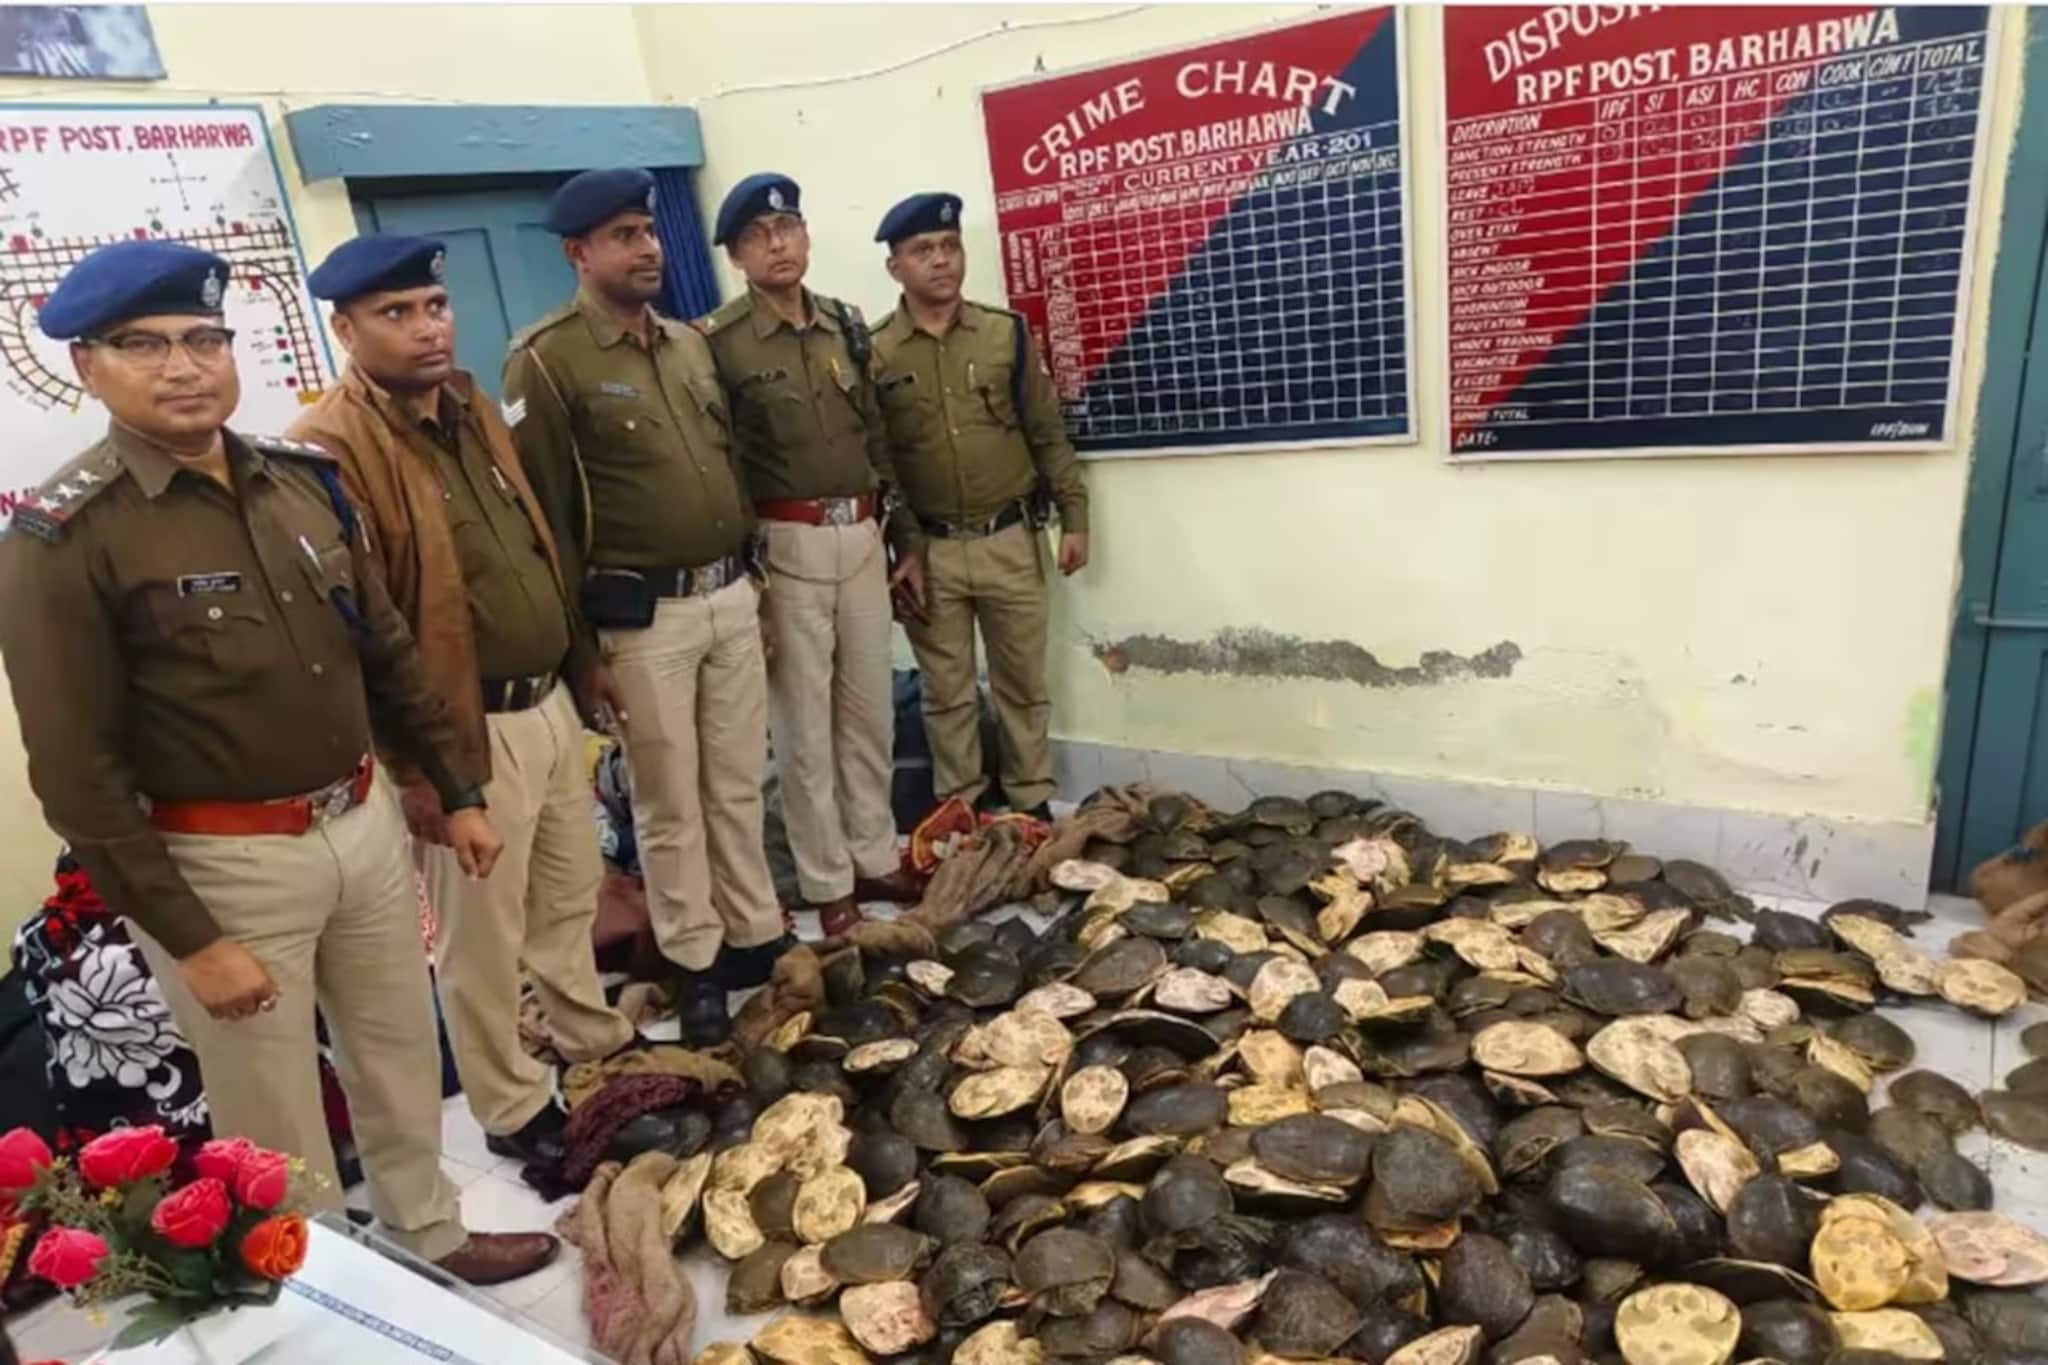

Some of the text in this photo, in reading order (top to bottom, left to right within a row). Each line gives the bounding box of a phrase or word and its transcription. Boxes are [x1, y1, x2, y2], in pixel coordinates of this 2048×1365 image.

[1516, 65, 1585, 104] RPF
[1689, 9, 1899, 76] BARHARWA
[1687, 85, 1715, 107] ASI
[1734, 79, 1759, 100] HC
[1921, 40, 1979, 69] TOTAL
[1021, 60, 1357, 176] CRIME CHART
[1060, 145, 1111, 178] RPF
[1124, 155, 1241, 193] CURRENT
[1509, 154, 1582, 175] STRENGTH
[1451, 207, 1483, 223] REST
[1451, 221, 1520, 244] OVER STAY
